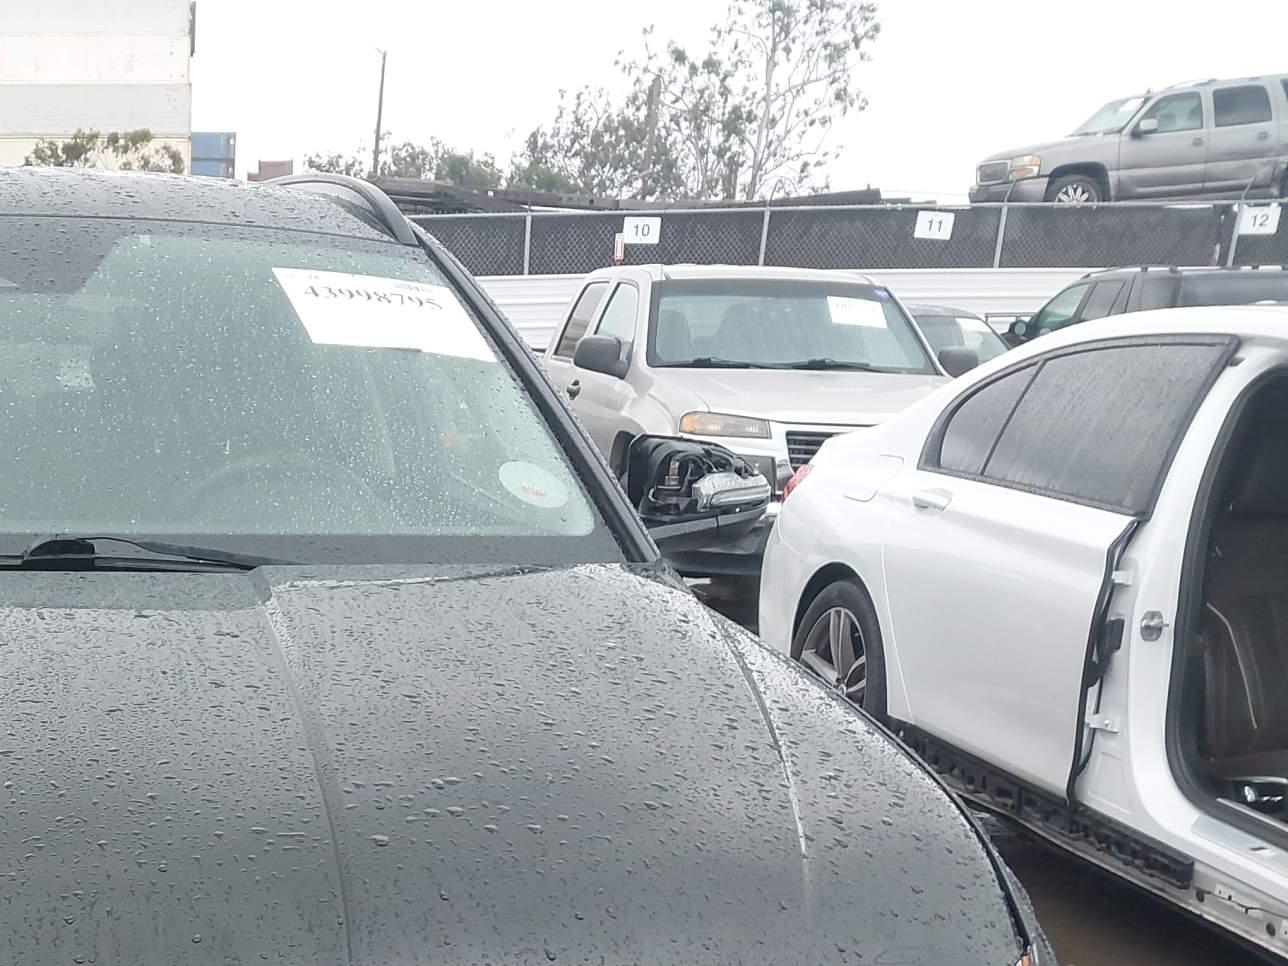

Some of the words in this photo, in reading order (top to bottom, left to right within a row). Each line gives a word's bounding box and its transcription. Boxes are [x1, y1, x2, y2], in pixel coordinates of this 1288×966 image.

[927, 218, 944, 233] 11
[1251, 213, 1270, 228] 12
[633, 223, 651, 237] 10
